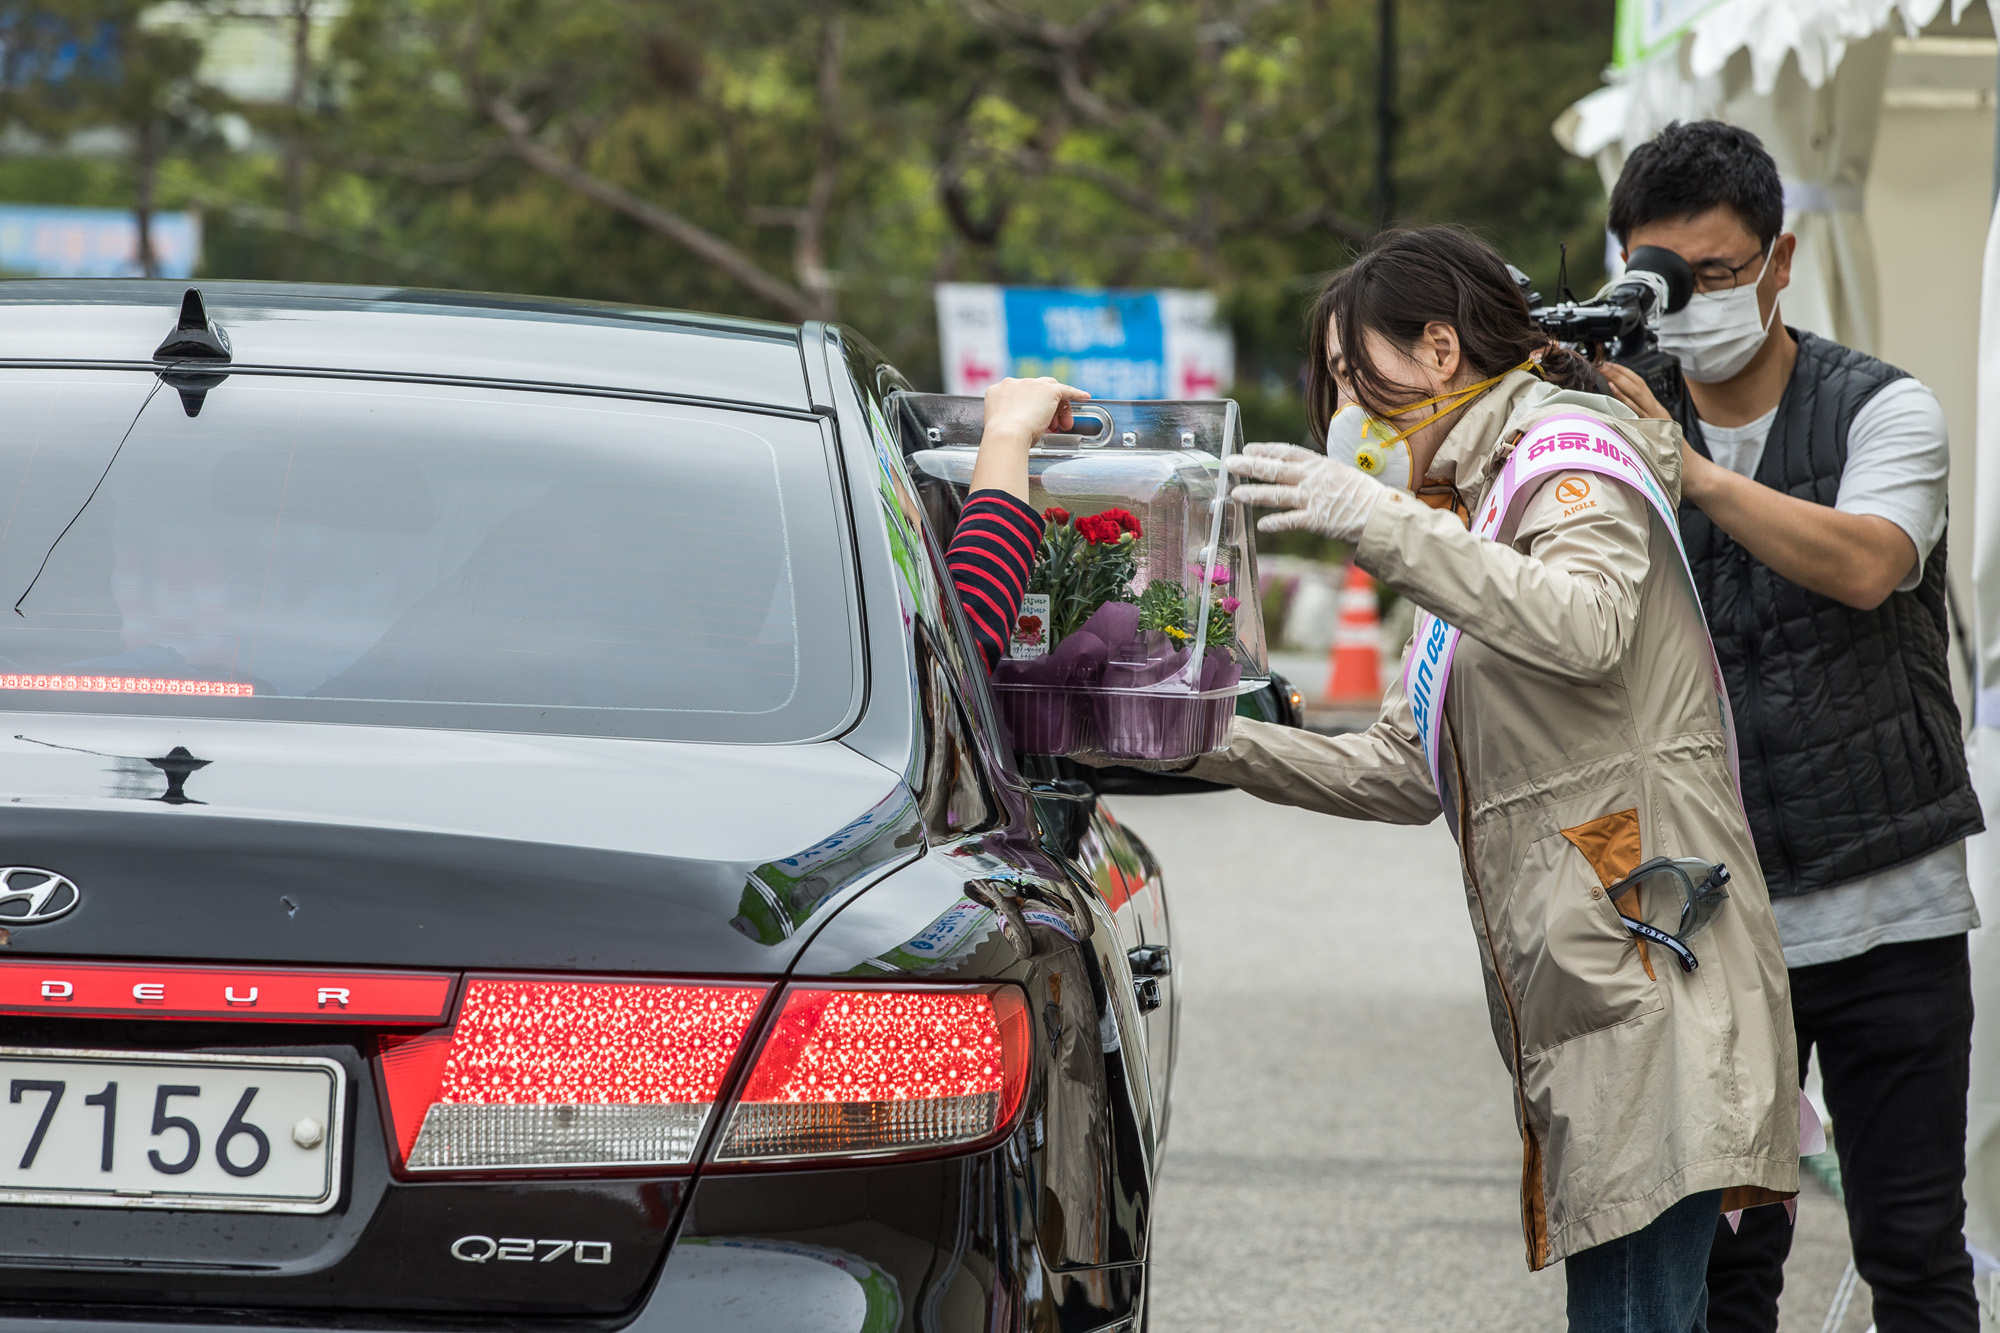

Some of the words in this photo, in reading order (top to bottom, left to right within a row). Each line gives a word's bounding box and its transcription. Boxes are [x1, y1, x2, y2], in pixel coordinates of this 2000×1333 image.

[1563, 500, 1597, 518] AIGLE
[41, 979, 350, 1006] DEUR
[10, 1078, 271, 1177] 7156
[450, 1234, 612, 1266] Q270
